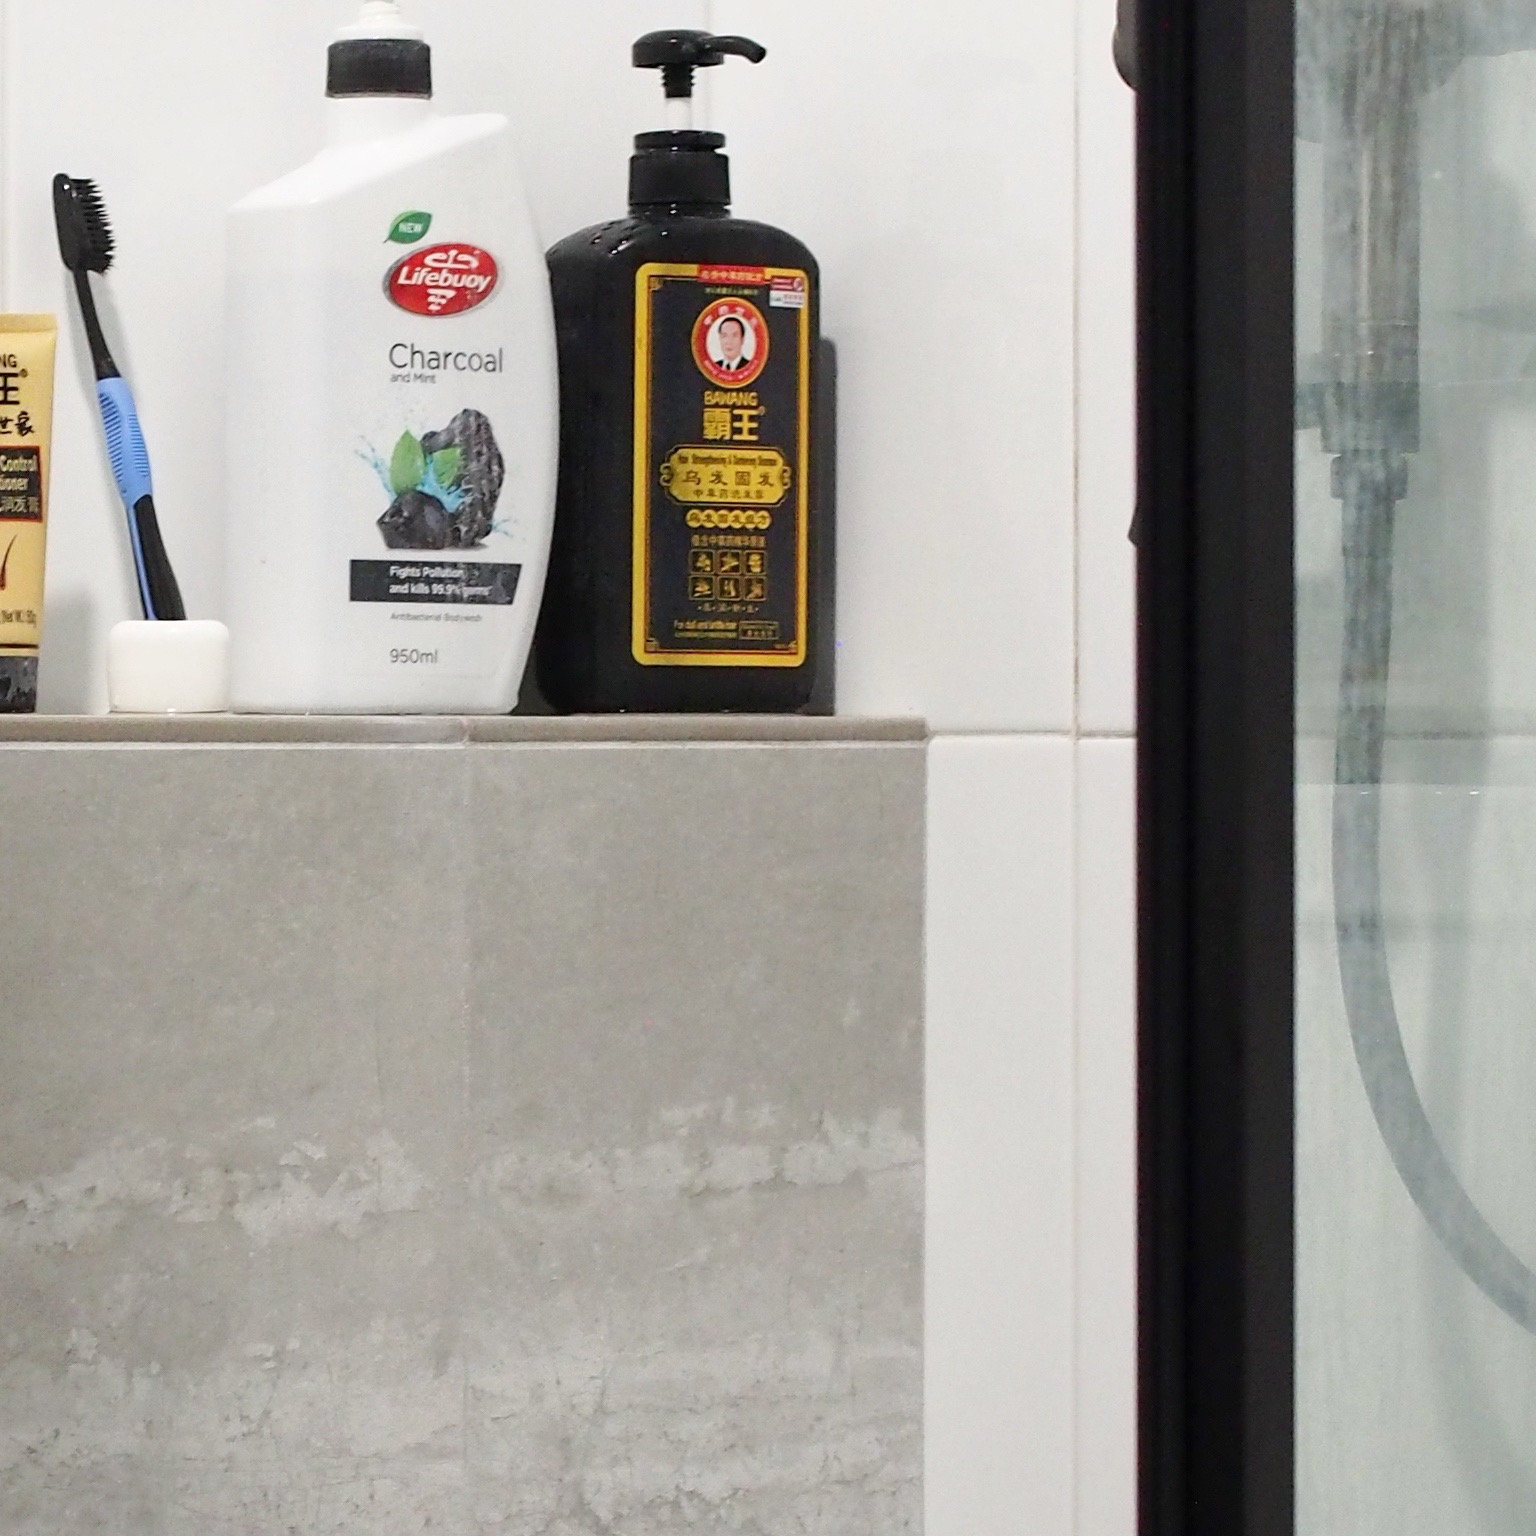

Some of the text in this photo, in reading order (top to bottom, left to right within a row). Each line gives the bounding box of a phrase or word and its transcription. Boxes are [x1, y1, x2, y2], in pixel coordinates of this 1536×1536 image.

[397, 265, 492, 293] Lifebuoy
[389, 343, 503, 373] Charcoal
[390, 374, 436, 384] and Mint
[704, 391, 758, 406] BAWANG
[0, 454, 38, 472] Control
[390, 566, 421, 579] Fights
[389, 583, 409, 594] and
[389, 648, 438, 664] 950ml
